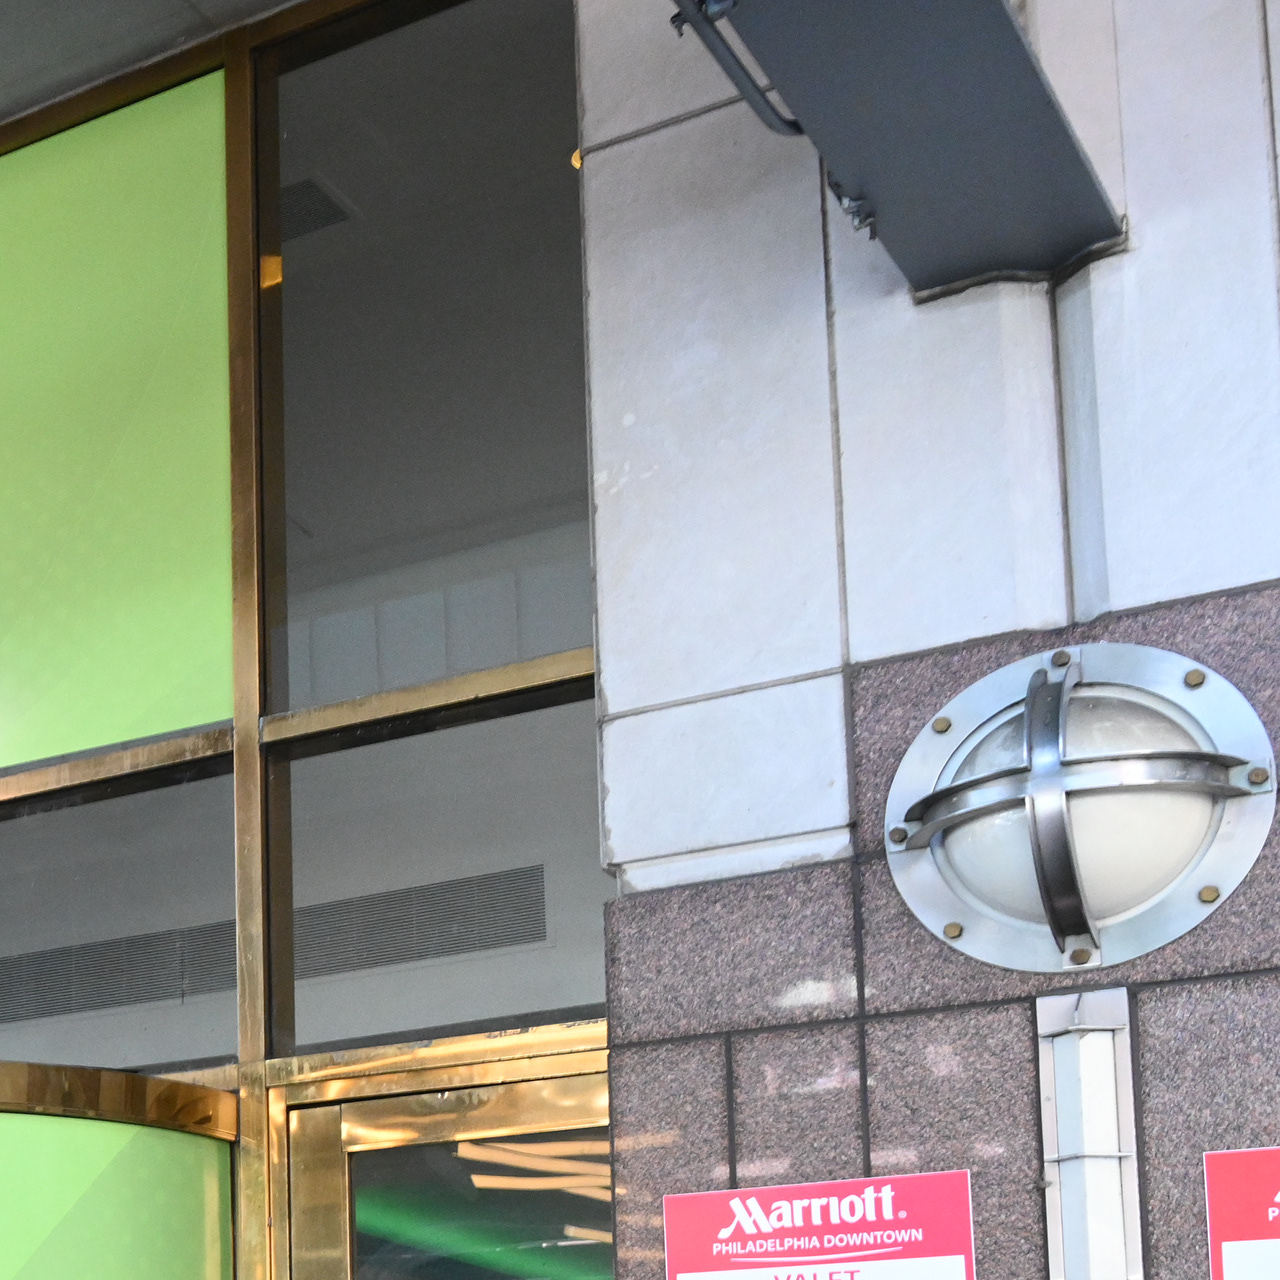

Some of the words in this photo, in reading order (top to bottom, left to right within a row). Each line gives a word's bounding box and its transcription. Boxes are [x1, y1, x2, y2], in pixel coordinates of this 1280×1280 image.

[718, 1184, 895, 1239] Marriott
[713, 1236, 820, 1256] PHILADELPHIA
[823, 1228, 923, 1248] DOWNTOWN
